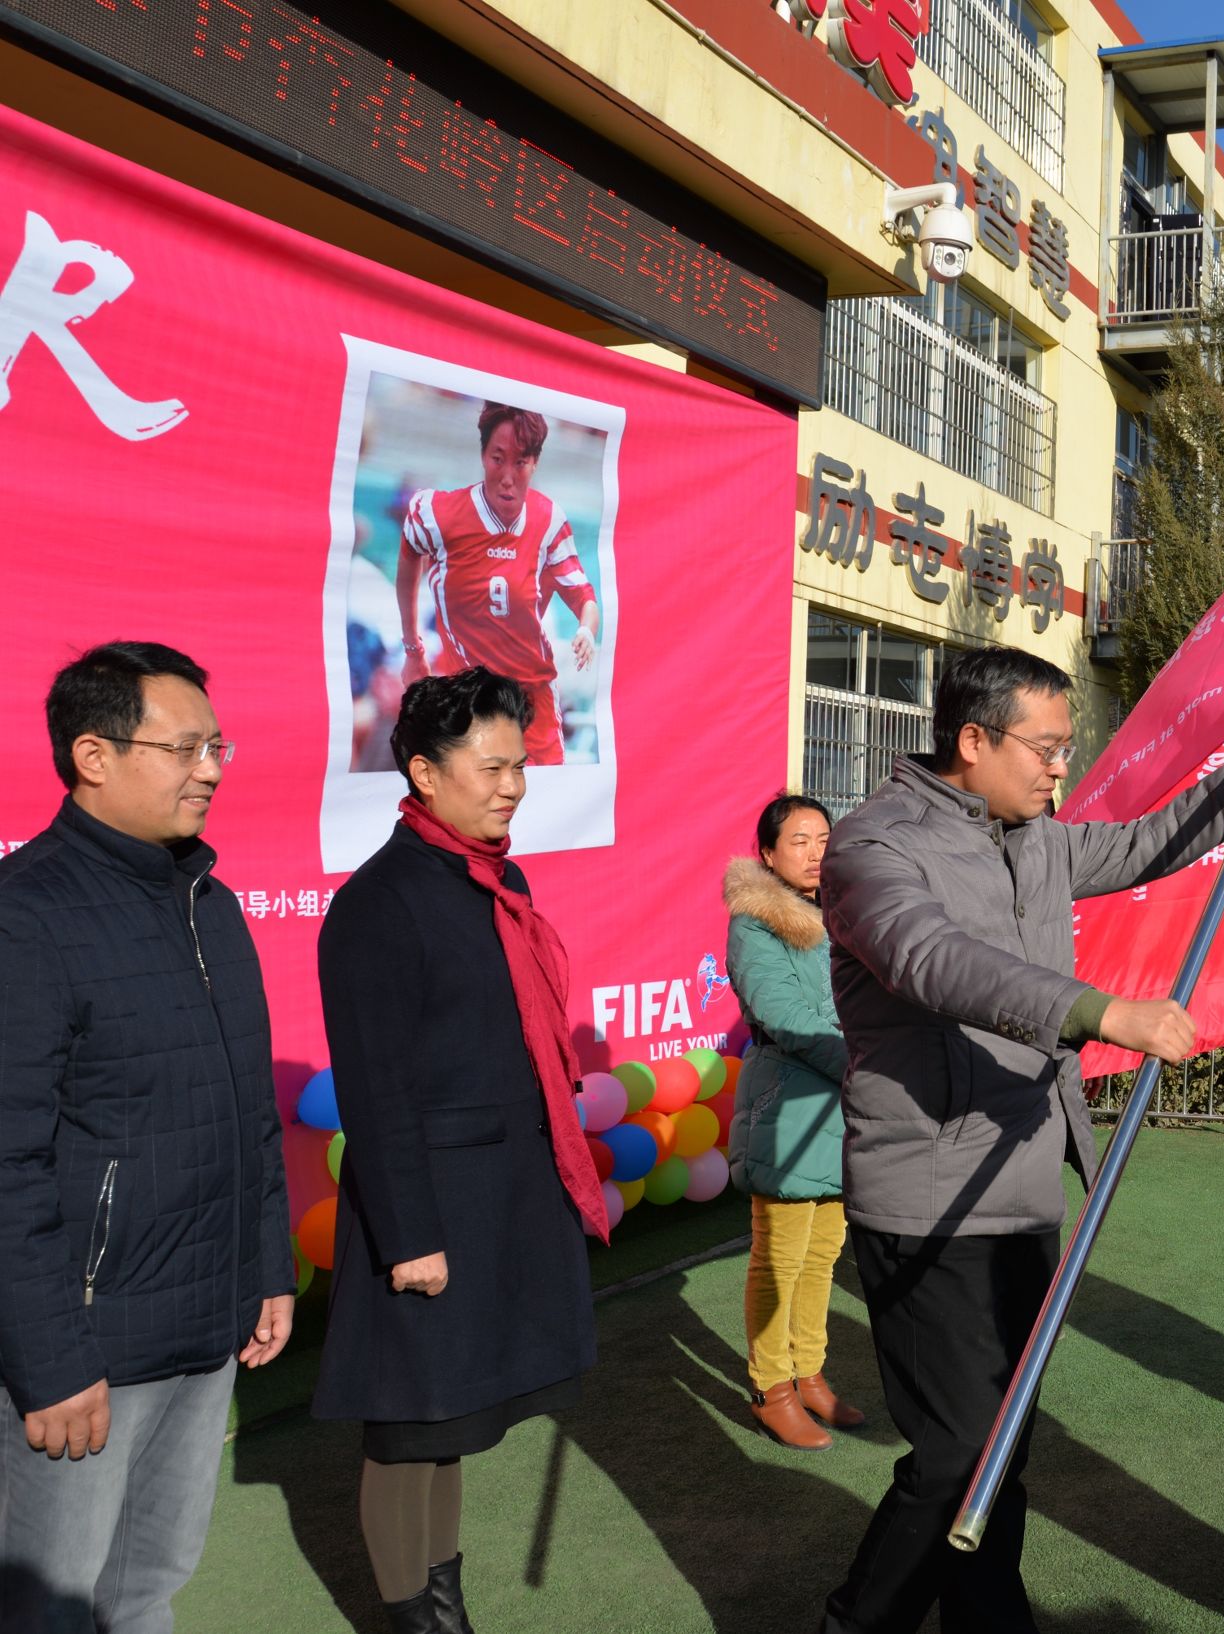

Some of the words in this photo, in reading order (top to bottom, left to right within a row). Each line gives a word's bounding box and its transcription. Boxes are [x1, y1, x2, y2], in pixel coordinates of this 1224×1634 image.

[487, 547, 517, 560] adidas
[800, 452, 1065, 634] 励志博学
[488, 576, 510, 617] 9
[592, 978, 693, 1043] FIFA
[650, 1039, 683, 1062] LIVE
[686, 1033, 728, 1051] YOUR
